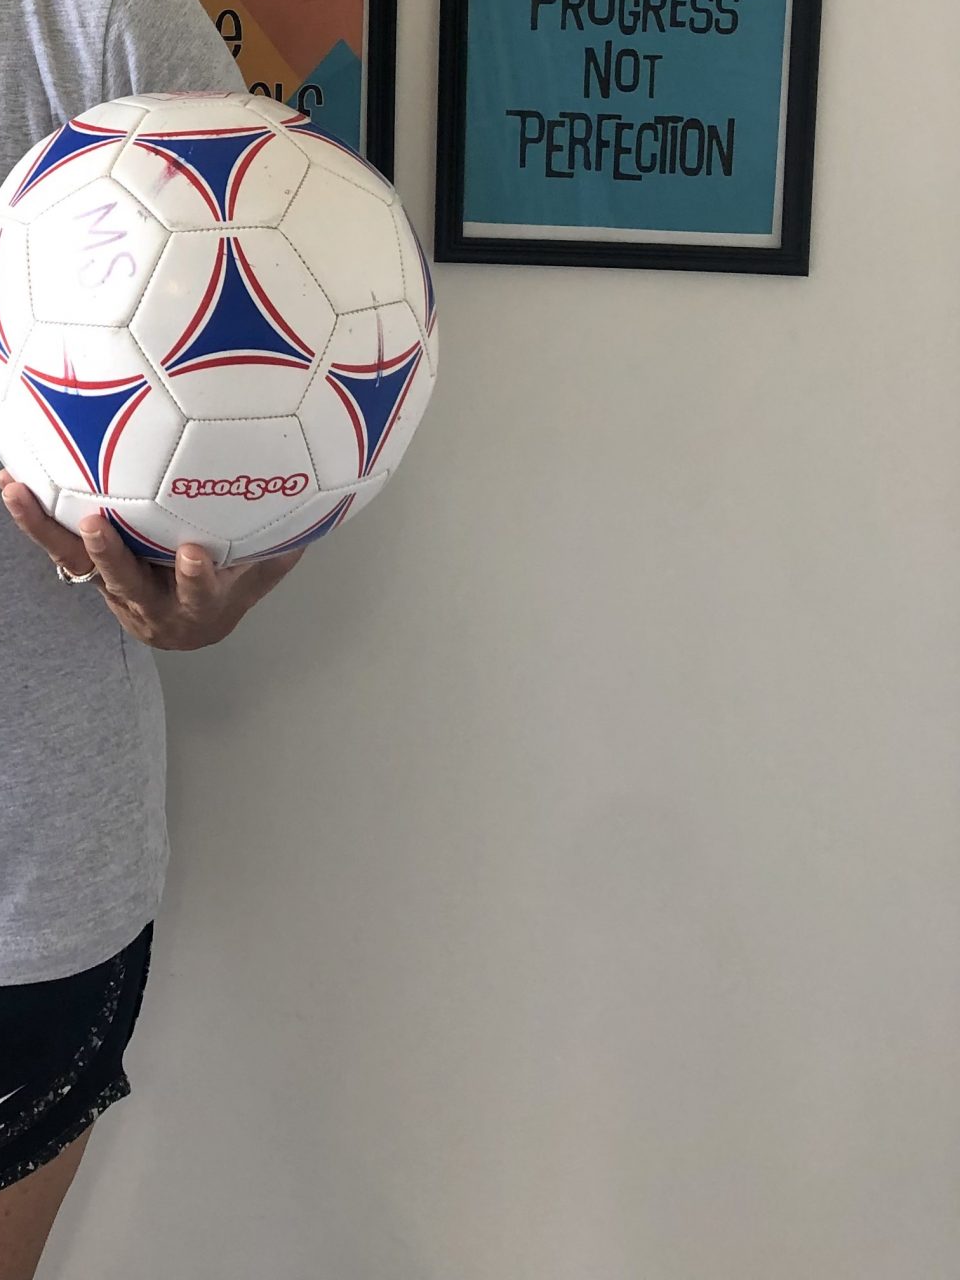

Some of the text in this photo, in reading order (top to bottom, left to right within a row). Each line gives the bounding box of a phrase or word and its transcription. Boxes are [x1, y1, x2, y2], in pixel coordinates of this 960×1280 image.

[583, 39, 664, 100] NOT
[505, 109, 736, 181] PERFECTION
[171, 472, 310, 501] GoSports
